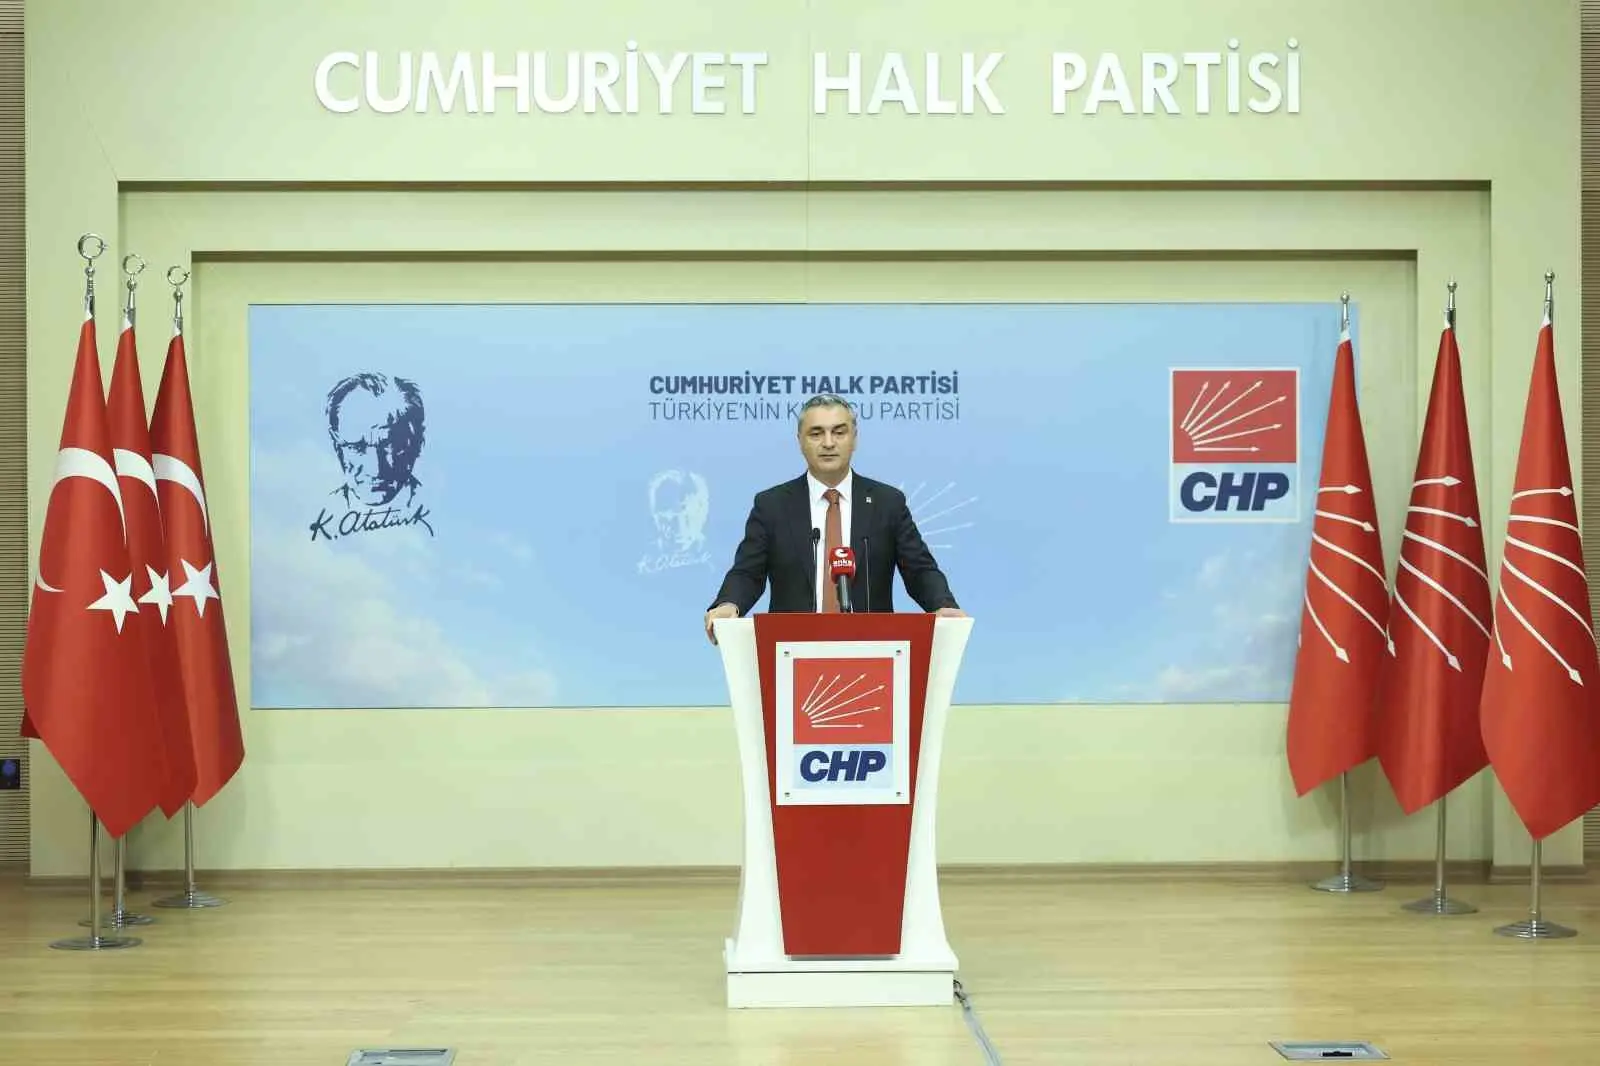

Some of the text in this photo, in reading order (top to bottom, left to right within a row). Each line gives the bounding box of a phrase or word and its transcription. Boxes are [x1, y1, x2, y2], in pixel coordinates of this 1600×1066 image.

[314, 38, 1301, 114] CUMHURİYET HALK PARTİSİ
[649, 370, 959, 394] CUMHURİYET HALK PARTİSİ
[648, 398, 780, 420] TÜRKİYE'NİN
[880, 398, 959, 420] PARTİSİ
[1180, 471, 1290, 512] CHP
[800, 750, 887, 782] CHP
